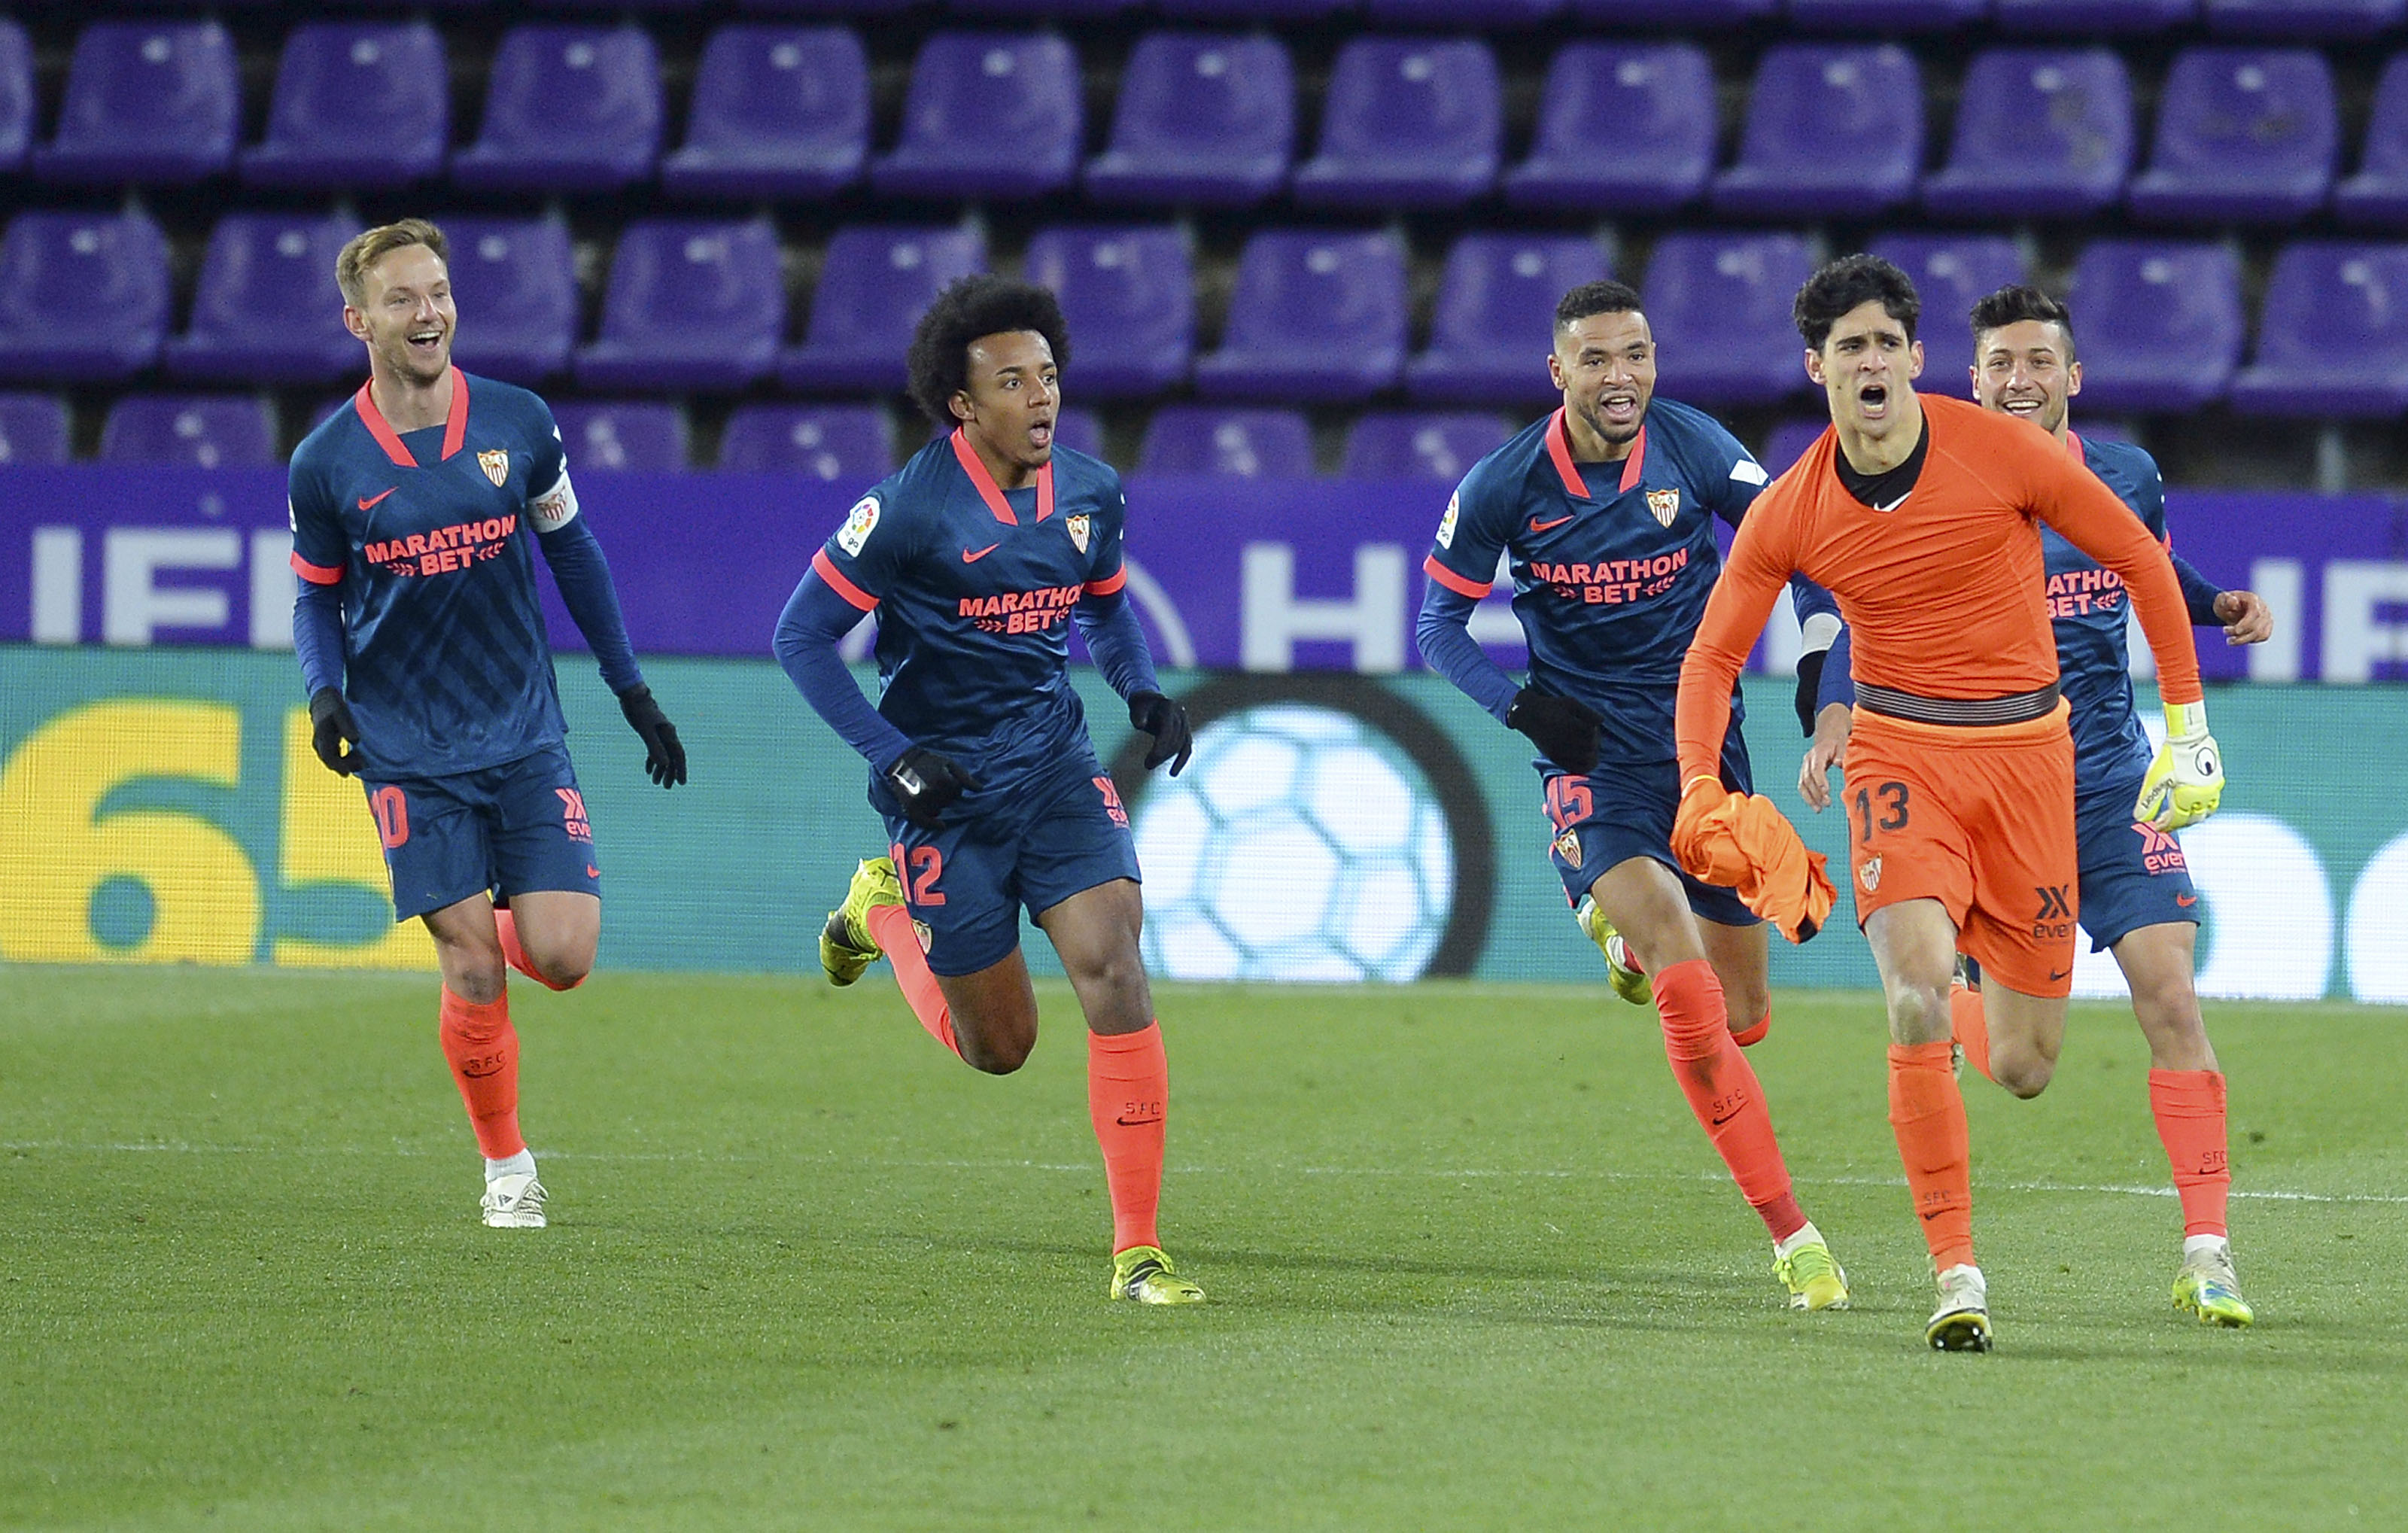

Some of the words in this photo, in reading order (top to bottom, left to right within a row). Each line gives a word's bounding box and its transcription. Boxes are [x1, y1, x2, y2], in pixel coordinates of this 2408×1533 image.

[364, 515, 516, 564] MARATHON
[419, 546, 476, 576] BET
[1529, 547, 1689, 584] MARATHON
[959, 583, 1085, 617] MARATHO
[1583, 582, 1642, 604] BET
[2046, 593, 2092, 619] BET
[1006, 610, 1056, 634] BET
[1546, 775, 1594, 829] 15
[1856, 781, 1909, 842] 13
[892, 841, 946, 906] 12
